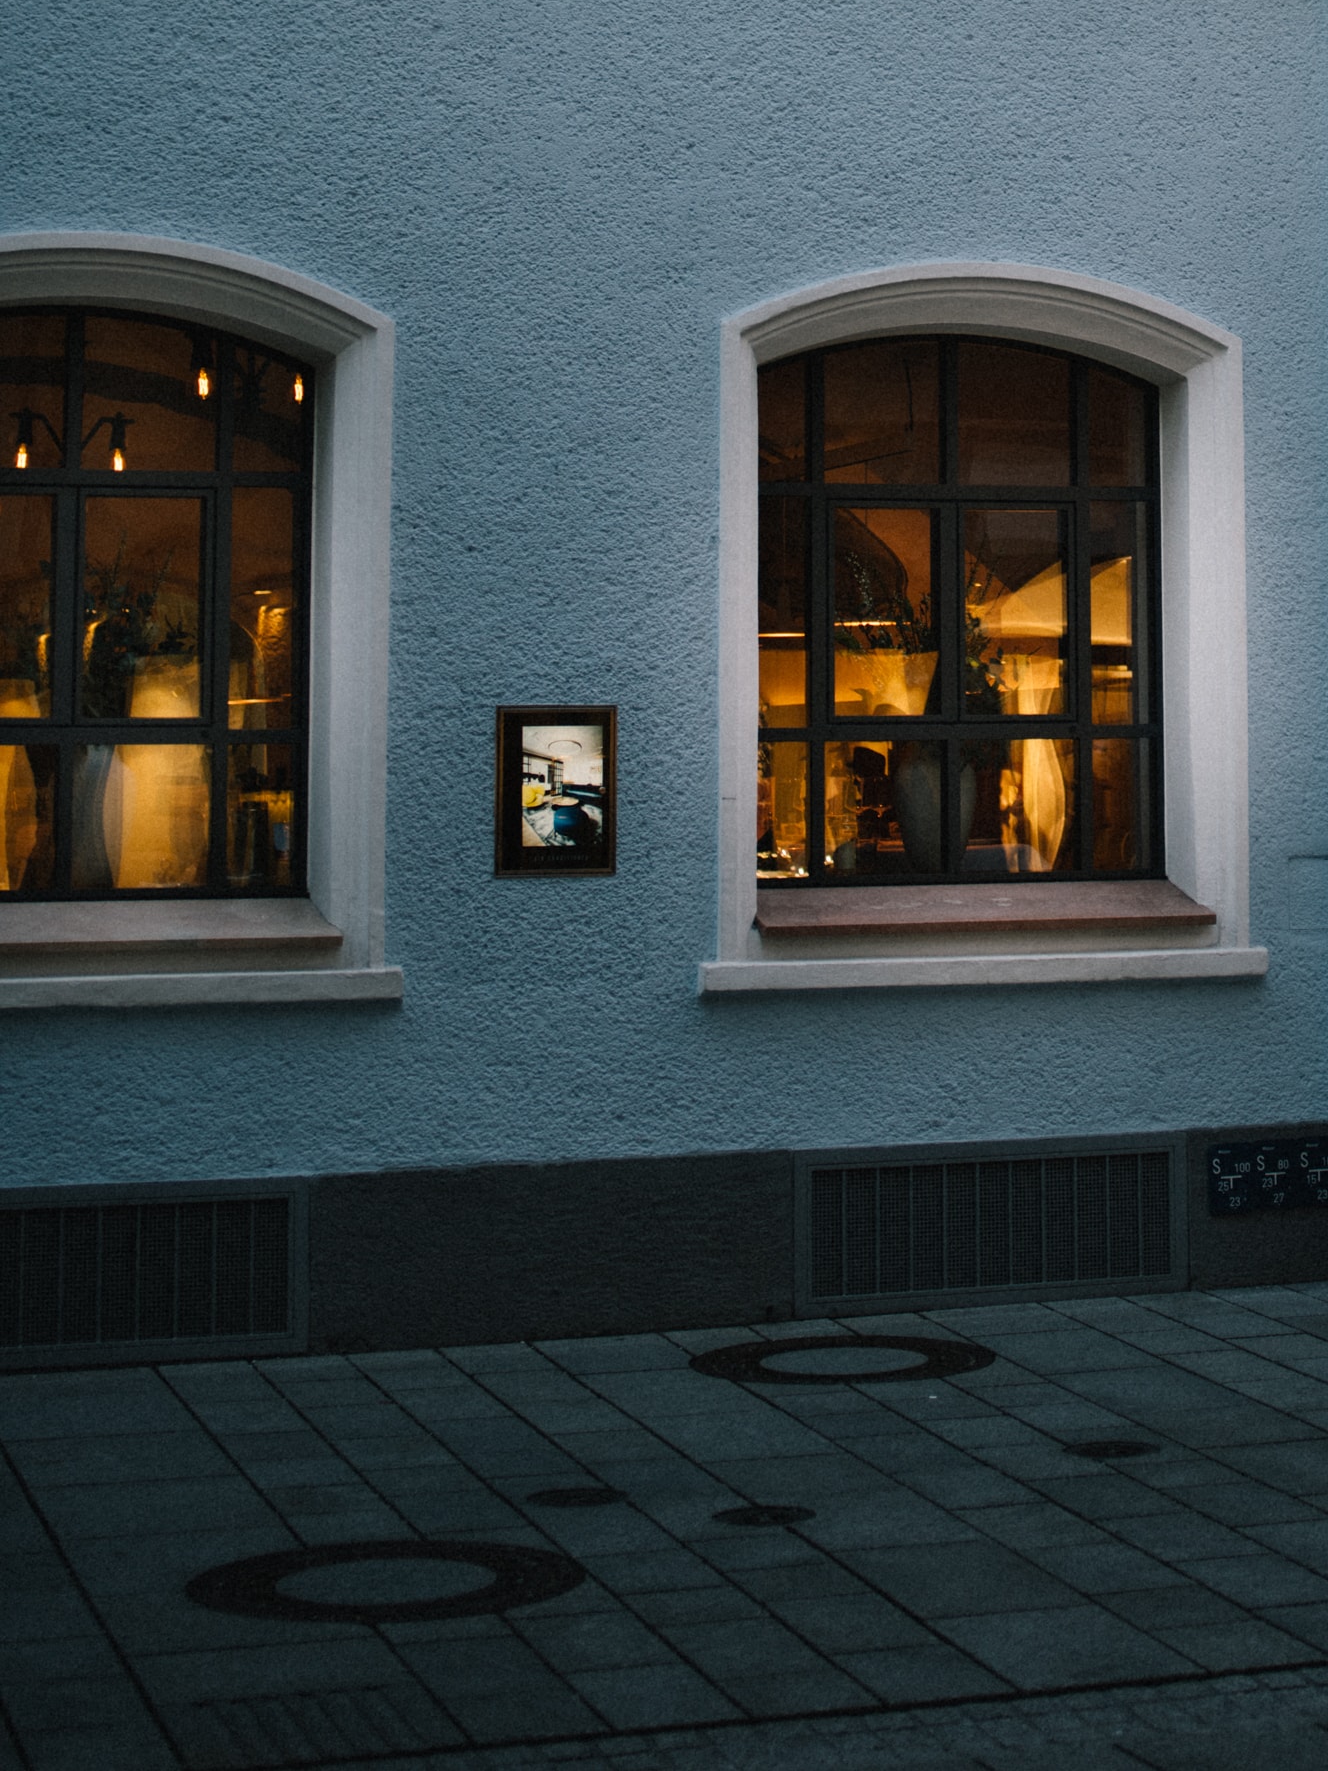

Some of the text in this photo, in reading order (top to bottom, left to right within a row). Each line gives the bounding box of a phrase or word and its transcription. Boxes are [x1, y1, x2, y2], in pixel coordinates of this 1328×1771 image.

[1212, 1158, 1250, 1174] S 100
[1256, 1155, 1265, 1171] S
[1300, 1151, 1309, 1168] S
